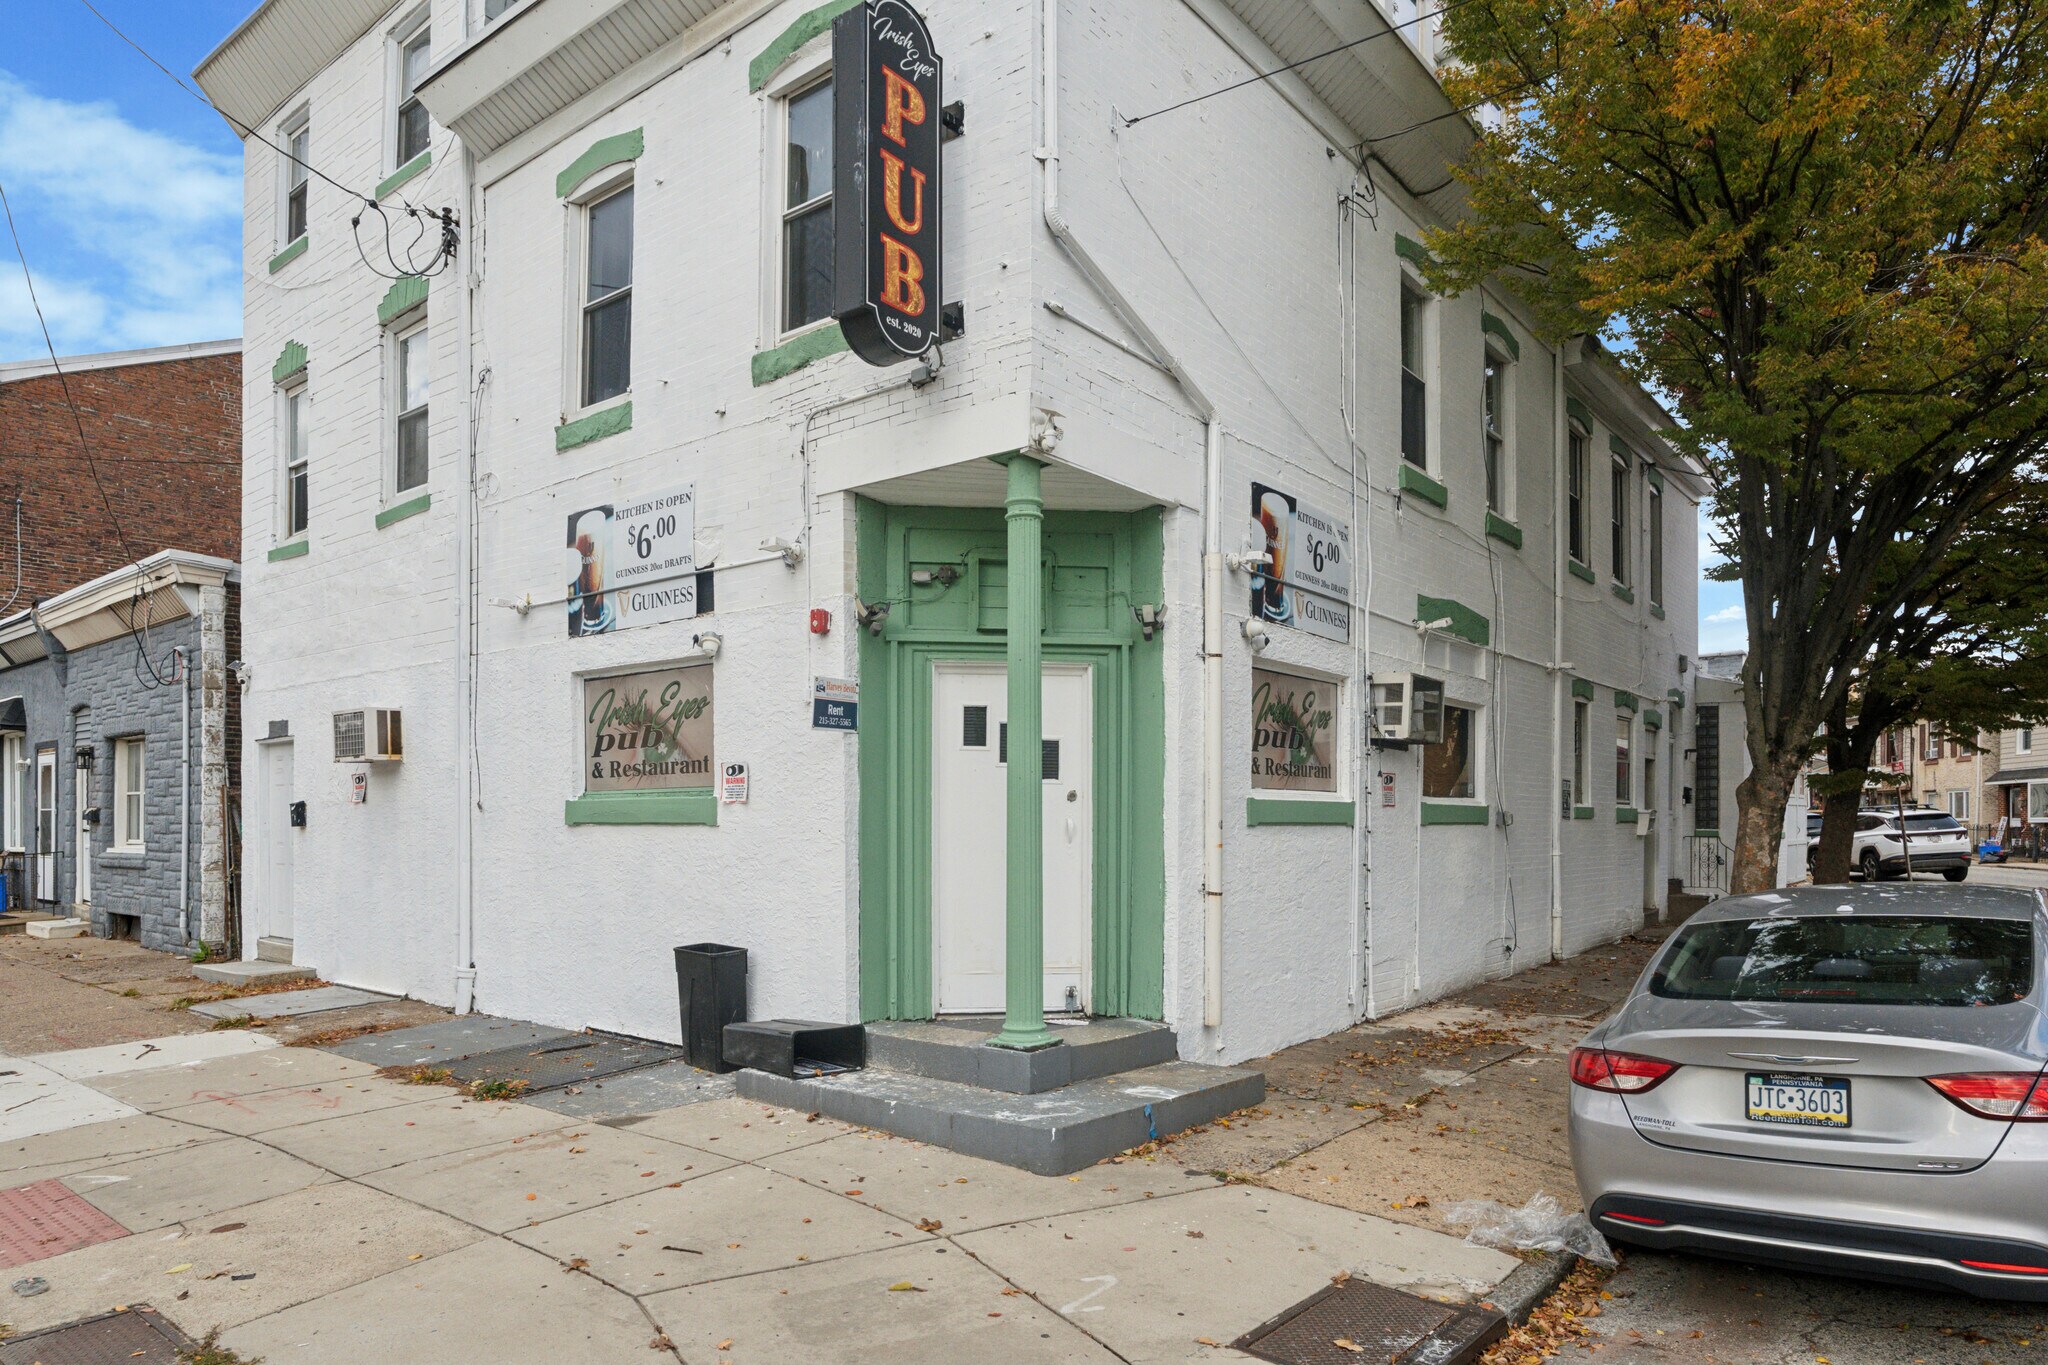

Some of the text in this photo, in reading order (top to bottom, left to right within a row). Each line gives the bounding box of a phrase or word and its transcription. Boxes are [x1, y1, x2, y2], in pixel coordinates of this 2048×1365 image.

[873, 16, 915, 50] Irish
[900, 48, 937, 82] Eyes
[880, 64, 927, 318] PUB
[886, 315, 922, 339] est. 2020
[614, 491, 692, 522] KITCHEN IS OPEN
[628, 514, 677, 560] $6.00
[1297, 510, 1326, 532] KITCHEN
[1326, 523, 1333, 536] IS
[1306, 531, 1341, 573] $6.00
[615, 563, 649, 579] GUINNESS
[664, 554, 692, 569] DRAFTS
[1295, 570, 1321, 586] GUINNESS
[1331, 582, 1349, 597] DRAFTS
[632, 585, 694, 613] GUINNESS
[1305, 600, 1347, 630] GUINNESS
[589, 680, 710, 741] Irish Eyes
[827, 703, 844, 716] Rent
[1252, 682, 1333, 746] Irish Eyes
[591, 724, 664, 758] pub
[1252, 726, 1305, 753] pub
[592, 755, 710, 779] & Restaurant
[1251, 756, 1332, 779] & Restaurant
[1771, 1079, 1824, 1088] PENNSYLVANIA
[1751, 1113, 1845, 1128] ReedmanToll.com
